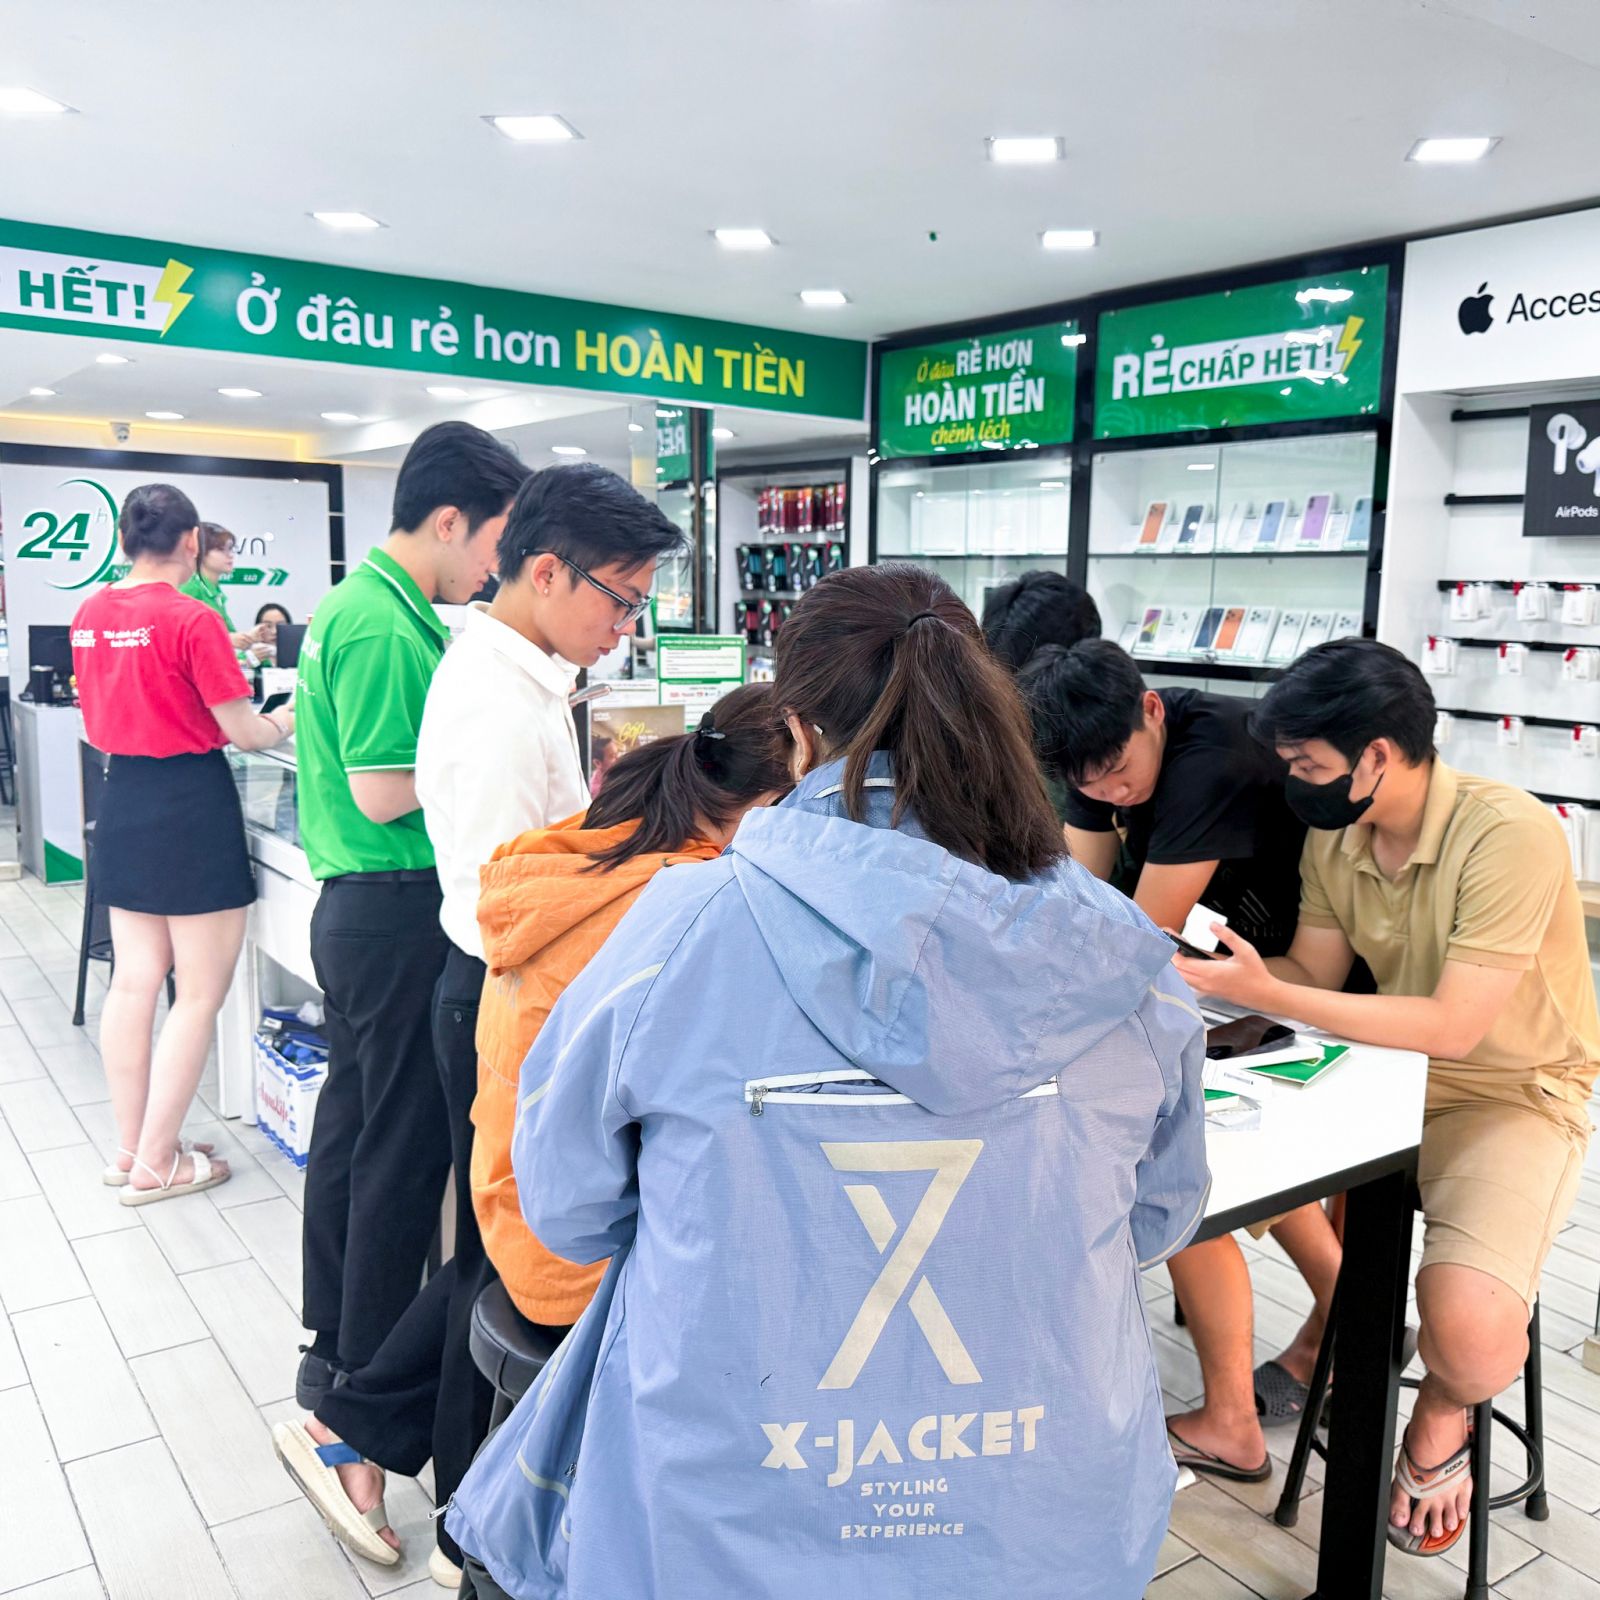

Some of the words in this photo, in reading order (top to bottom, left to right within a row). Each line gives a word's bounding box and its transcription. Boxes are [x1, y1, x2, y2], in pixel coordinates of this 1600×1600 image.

[18, 264, 146, 320] HẾT!
[235, 272, 281, 335] Ở
[296, 293, 394, 349] đâu
[410, 305, 460, 357] rẻ
[474, 313, 561, 369] hơn
[575, 328, 704, 386] HOÀN
[713, 341, 806, 398] TIỀN
[956, 338, 984, 376] RẺ
[985, 339, 1034, 372] HƠN
[1111, 334, 1172, 400] RẺ
[1179, 344, 1256, 386] CHẤP
[904, 382, 977, 426] HOÀN
[980, 368, 1046, 417] TIỀN
[1555, 506, 1599, 519] AirPods
[760, 1405, 1044, 1488] X-JACKET
[861, 1477, 948, 1497] STYLING
[873, 1503, 935, 1518] YOUR
[840, 1523, 964, 1539] EXPERIENCE
